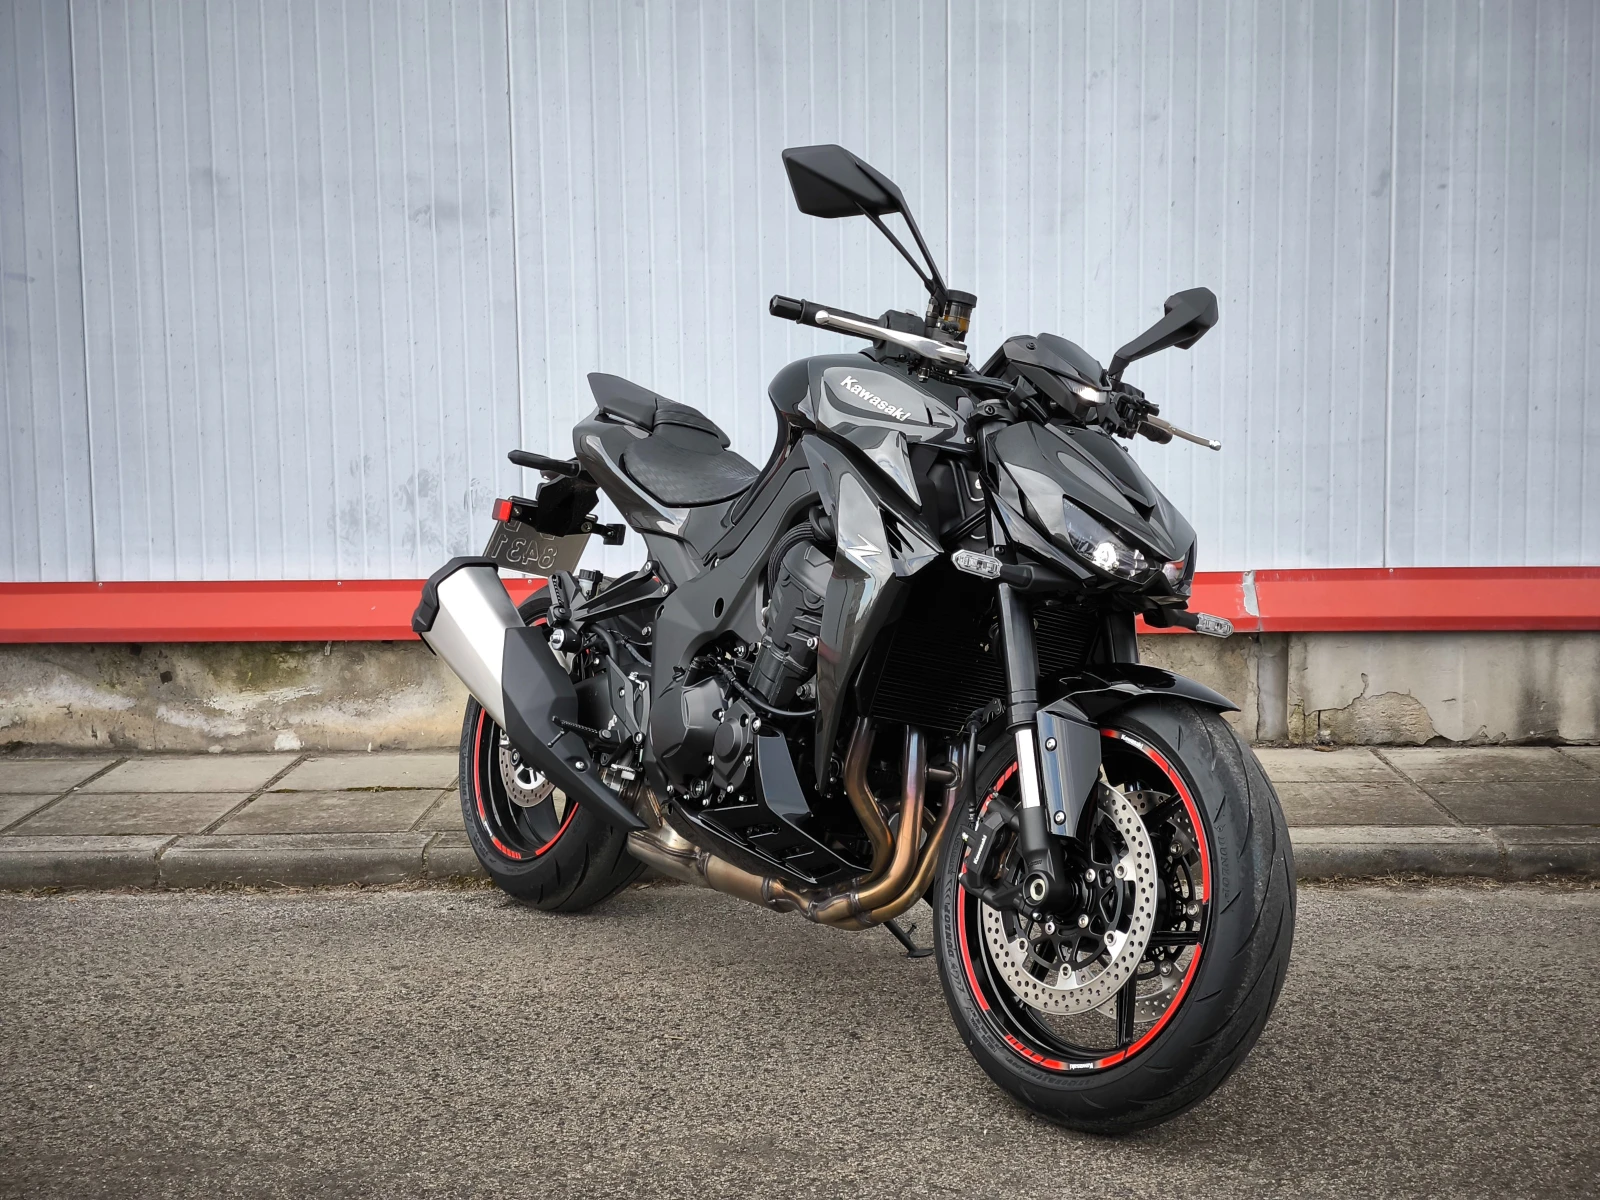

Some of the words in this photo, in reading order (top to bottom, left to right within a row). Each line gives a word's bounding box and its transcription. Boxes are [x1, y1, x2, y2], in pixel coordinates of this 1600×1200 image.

[840, 375, 912, 422] Kawasaki
[1218, 836, 1231, 899] DUNLOP
[943, 904, 955, 959] DUNLOP
